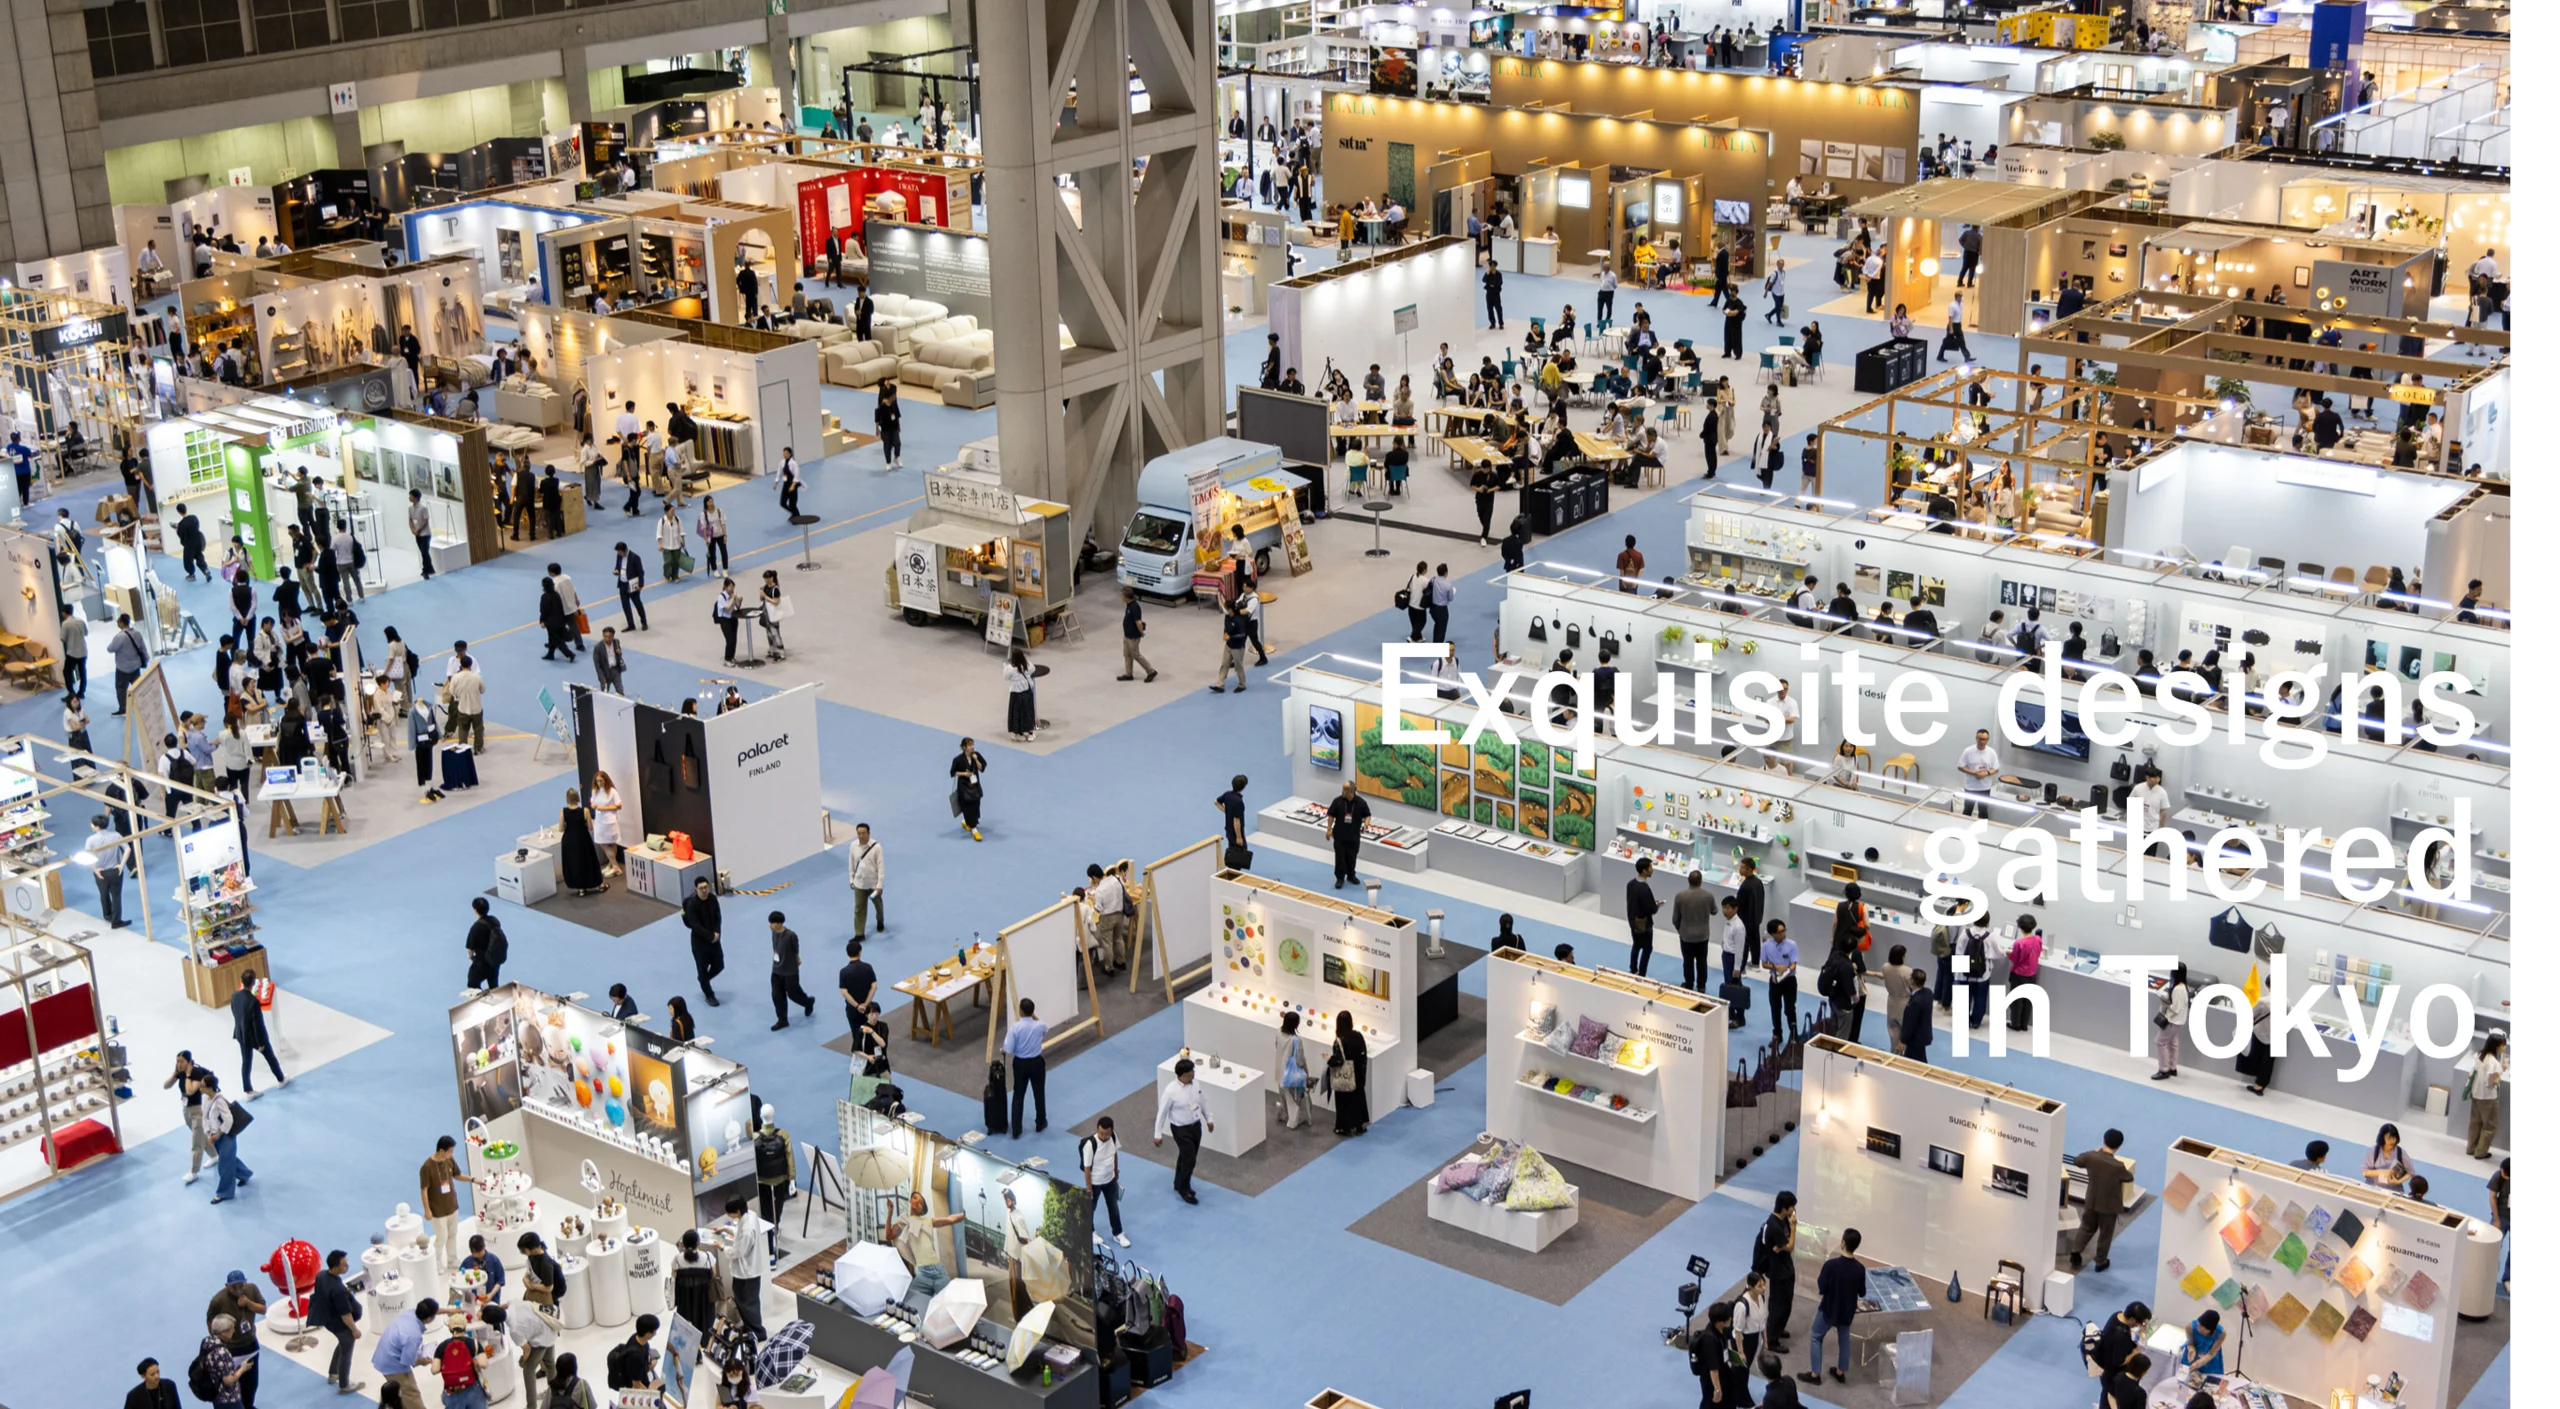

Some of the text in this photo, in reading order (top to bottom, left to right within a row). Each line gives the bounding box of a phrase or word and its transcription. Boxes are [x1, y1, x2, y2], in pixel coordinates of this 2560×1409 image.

[1498, 62, 1543, 78] ITALIA
[1857, 92, 1909, 109] ITALIA
[1704, 134, 1758, 154] ITALIA
[800, 184, 817, 192] IWATA
[898, 183, 920, 192] IWATA
[2350, 277, 2388, 288] WORK
[2351, 269, 2380, 279] ART
[2349, 285, 2384, 294] STUDIO
[58, 322, 103, 343] KOCHI
[930, 481, 1009, 511] 日本茶専門店
[1192, 485, 1220, 506] TACOS
[902, 573, 937, 592] 日本茶
[737, 733, 789, 768] palaset
[749, 760, 781, 778] FINLAND
[1323, 934, 1391, 959] TAKUMI NAGAHORI DESIGN
[1625, 1021, 1643, 1031] YUMI
[1644, 1027, 1688, 1044] YOSHIMOTO
[1640, 1034, 1693, 1054] PORTRAIT LAB
[1948, 1116, 1977, 1130] SUIGEN
[1997, 1131, 2022, 1143] design
[2023, 1138, 2038, 1148] Inc.
[609, 1169, 673, 1213] Hoptimist
[637, 1249, 649, 1257] JOIN
[629, 1264, 660, 1279] MOVEMENT
[634, 1260, 654, 1270] HAPPY
